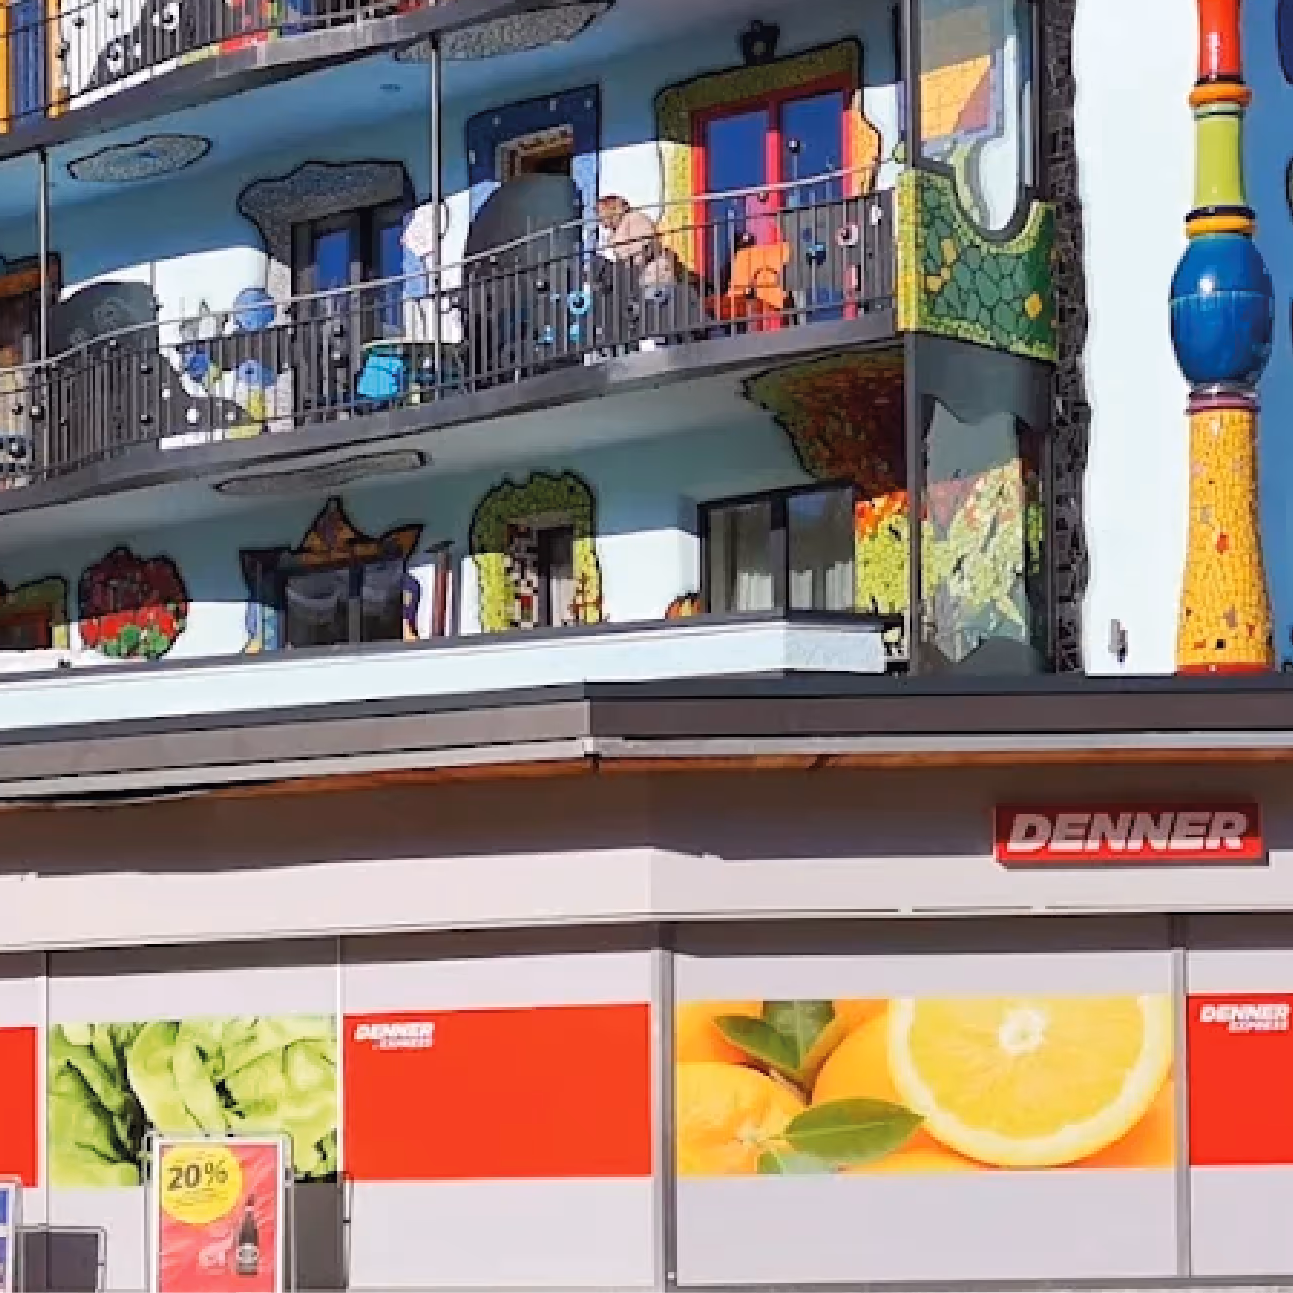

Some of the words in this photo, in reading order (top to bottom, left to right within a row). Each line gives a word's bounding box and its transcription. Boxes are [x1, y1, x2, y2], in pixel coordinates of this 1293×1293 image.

[1006, 811, 1249, 853] DENNER
[1199, 1003, 1291, 1023] DENNER
[353, 1022, 436, 1041] DENNER
[167, 1160, 229, 1192] 20%
